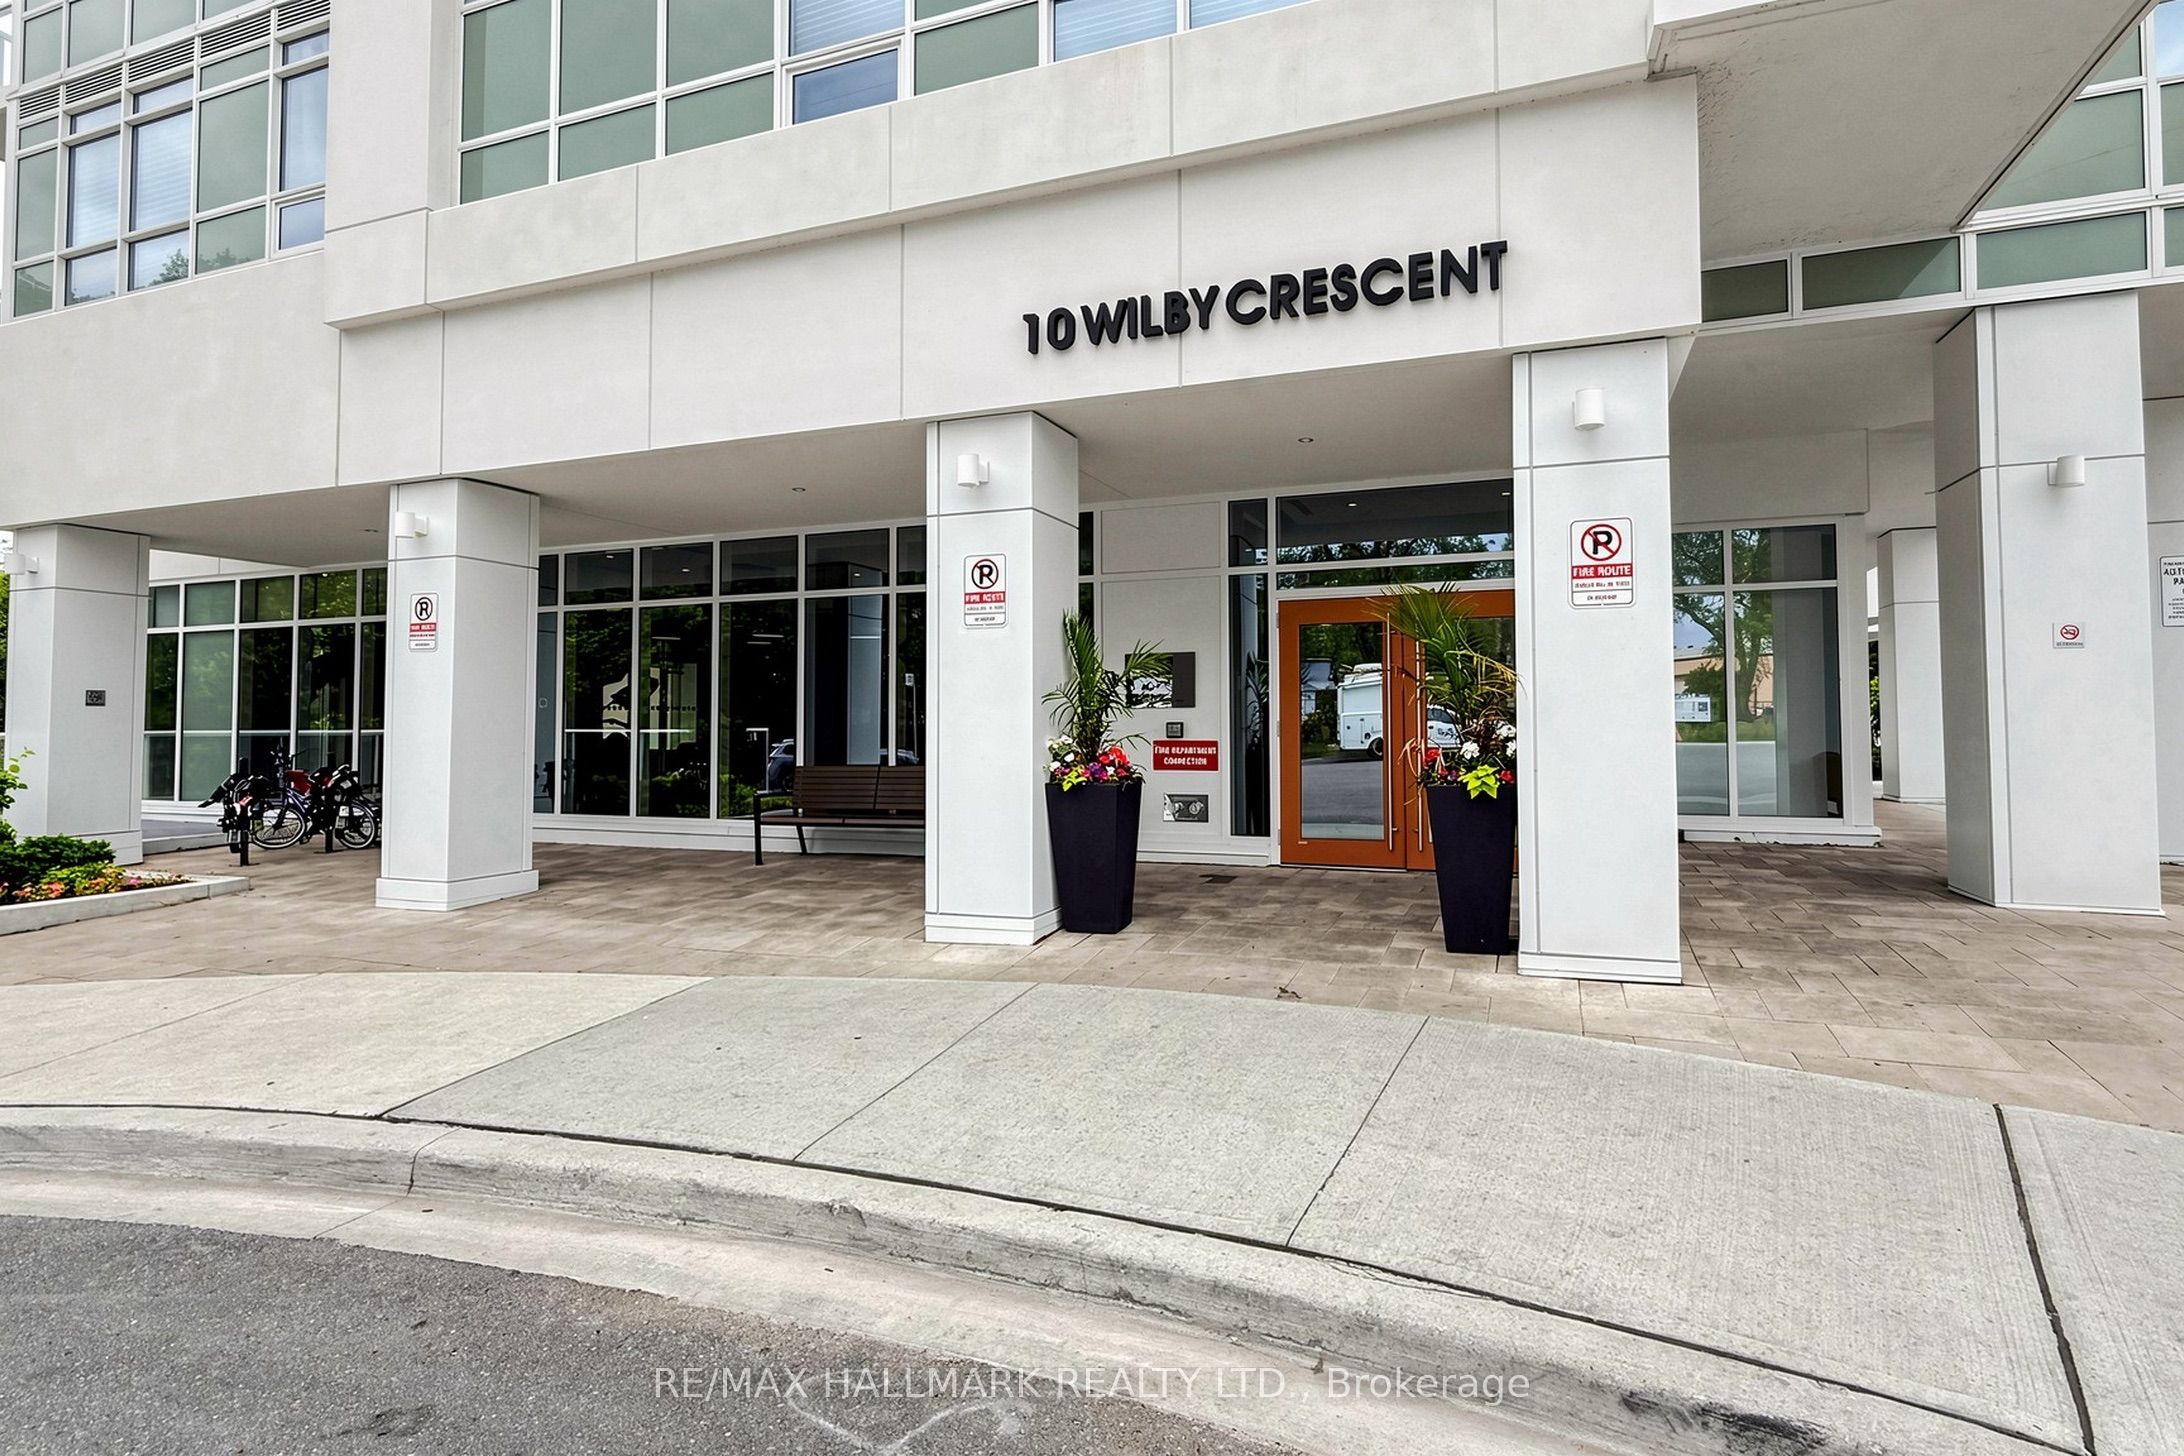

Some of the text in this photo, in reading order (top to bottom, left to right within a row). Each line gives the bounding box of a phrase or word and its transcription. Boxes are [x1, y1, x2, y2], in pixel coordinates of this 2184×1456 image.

[1023, 240, 1508, 355] 10 WILBY CRESCENT
[1597, 565, 1631, 576] ROUTE
